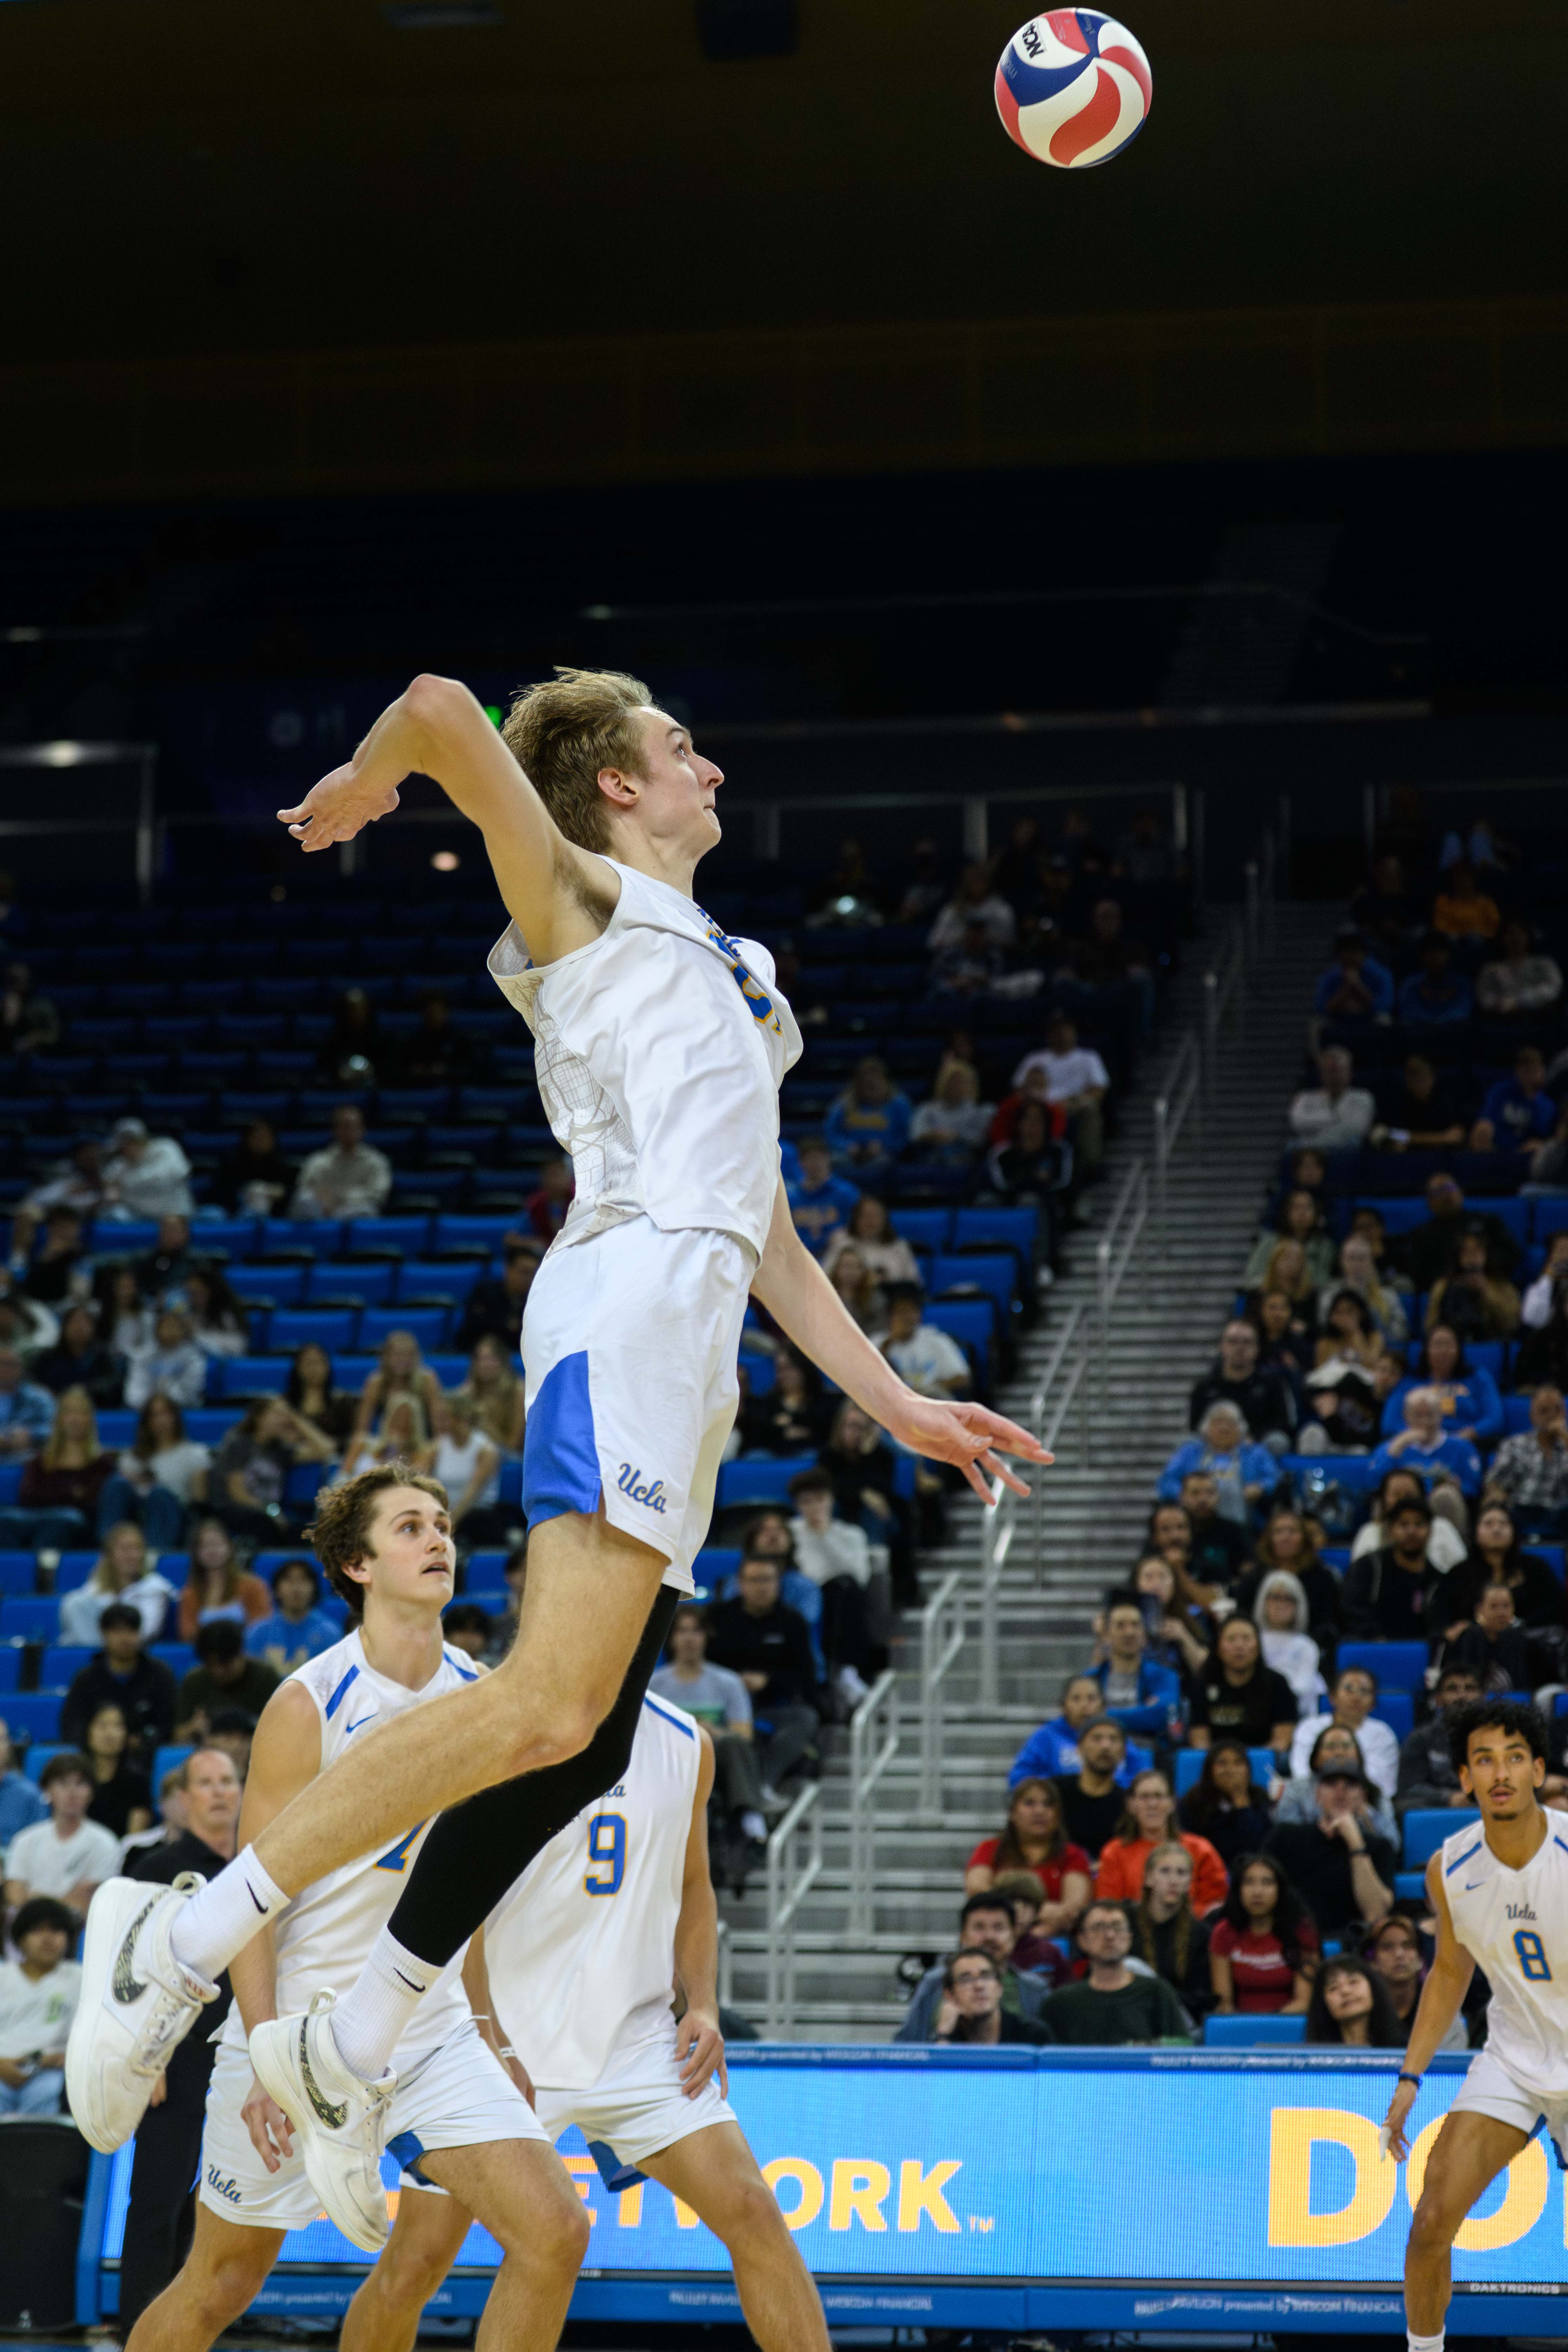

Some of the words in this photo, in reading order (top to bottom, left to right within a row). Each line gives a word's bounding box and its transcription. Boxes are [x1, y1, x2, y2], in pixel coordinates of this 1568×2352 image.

[618, 1462, 667, 1514] Ucla
[583, 1811, 628, 1897] 9
[1511, 1929, 1554, 1983] 8
[208, 2164, 242, 2203] Ucla
[1268, 2107, 1568, 2251] DO
[1470, 2283, 1560, 2294] DAKTRONICS
